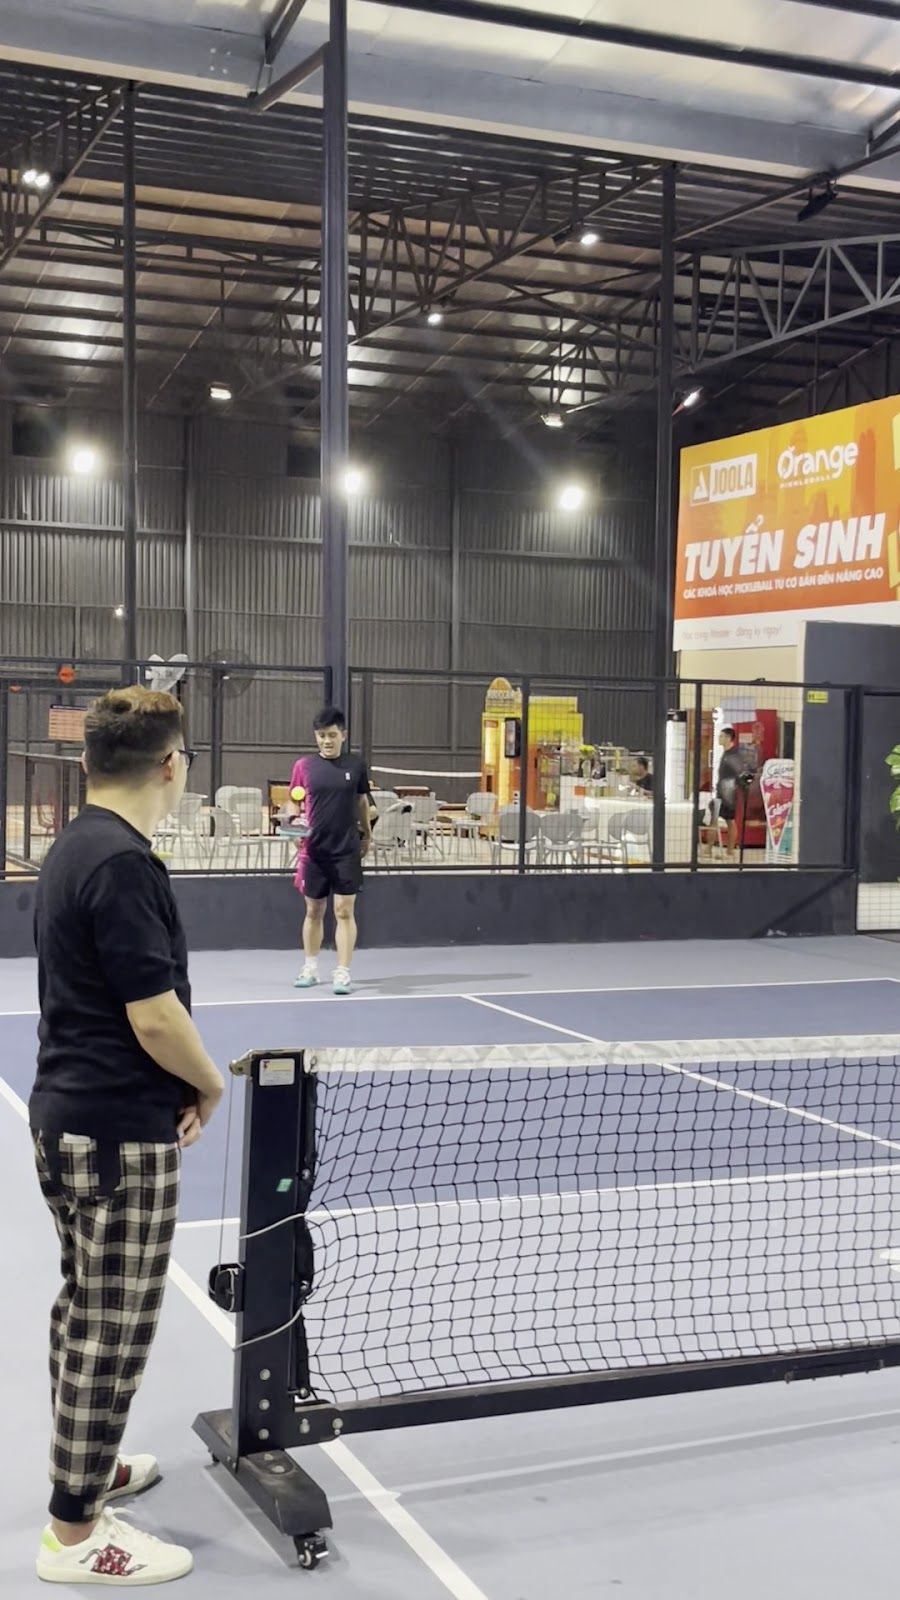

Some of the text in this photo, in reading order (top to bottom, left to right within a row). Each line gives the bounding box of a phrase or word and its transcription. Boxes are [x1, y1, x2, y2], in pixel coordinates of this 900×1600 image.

[712, 461, 754, 495] JOOLA
[685, 512, 886, 582] TUYỂN SINH
[864, 566, 884, 580] CAO
